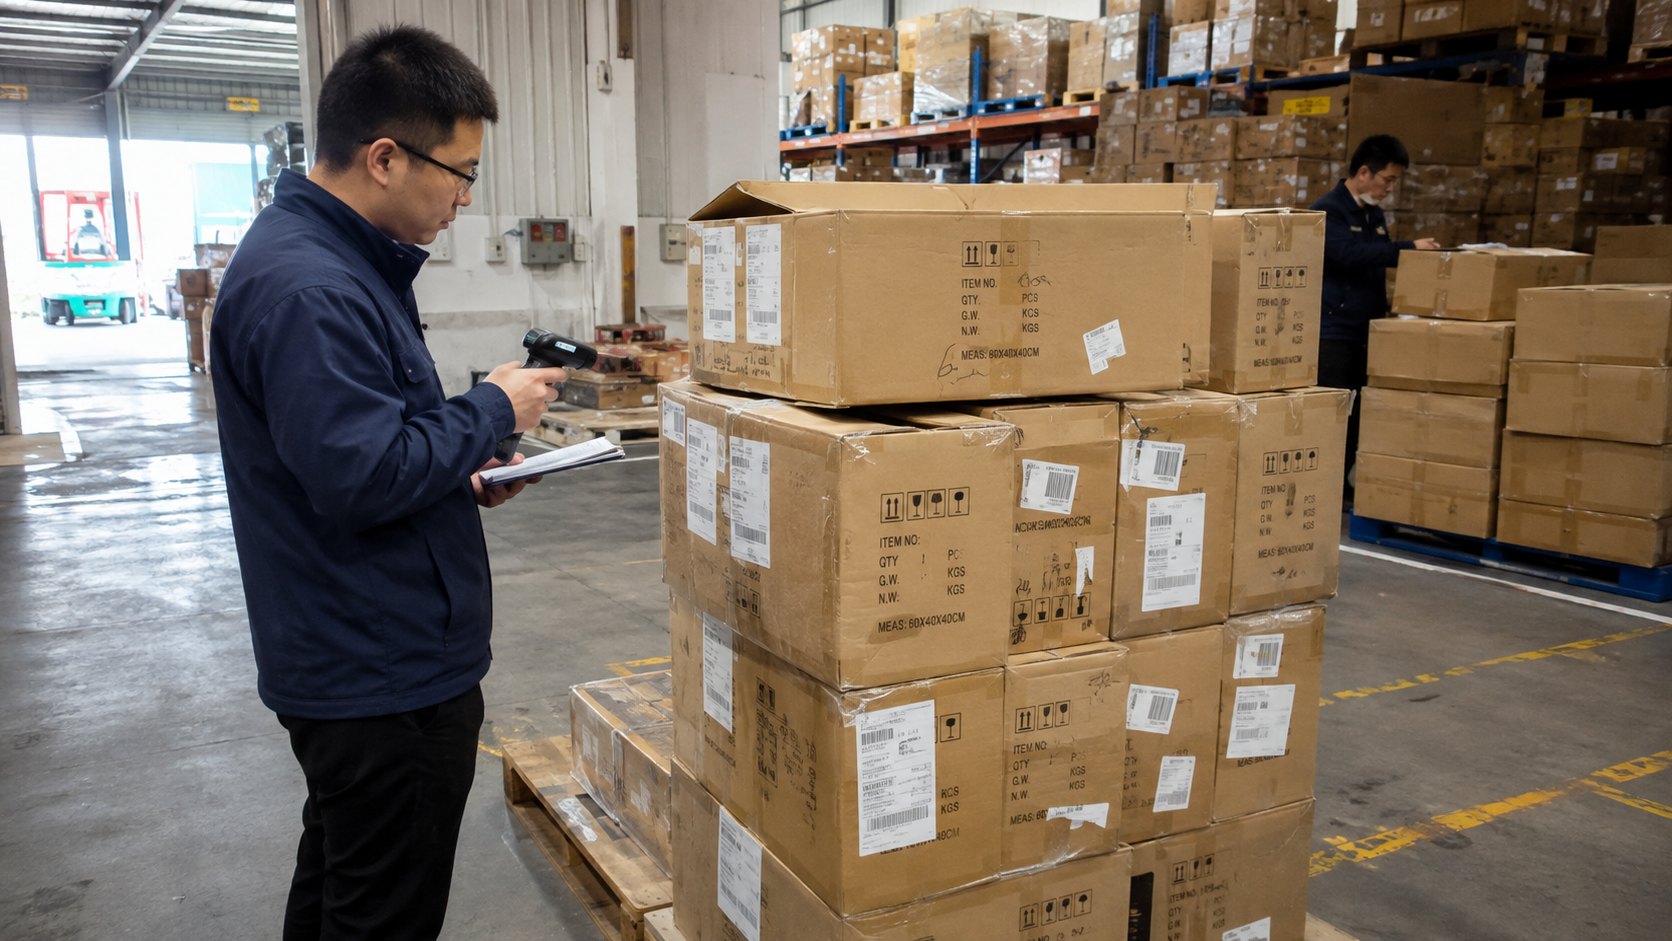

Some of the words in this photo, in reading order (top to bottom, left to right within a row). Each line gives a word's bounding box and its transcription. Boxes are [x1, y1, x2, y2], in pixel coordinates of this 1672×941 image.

[961, 278, 982, 288] ITEM
[983, 278, 998, 288] NO.
[1022, 293, 1039, 303] PCS
[961, 310, 980, 321] G.W.
[961, 326, 980, 336] N.W.
[1022, 323, 1040, 333] KGS
[879, 536, 902, 548] ITEM
[904, 534, 920, 546] NO:
[879, 574, 900, 586] G.W.
[947, 566, 966, 578] KGS
[947, 583, 965, 596] KGS
[878, 619, 907, 633] MEAS:
[908, 612, 966, 629] 60X40X40CM
[1013, 743, 1033, 755] ITEM
[1069, 765, 1086, 777] KGS
[940, 801, 959, 815] KGS
